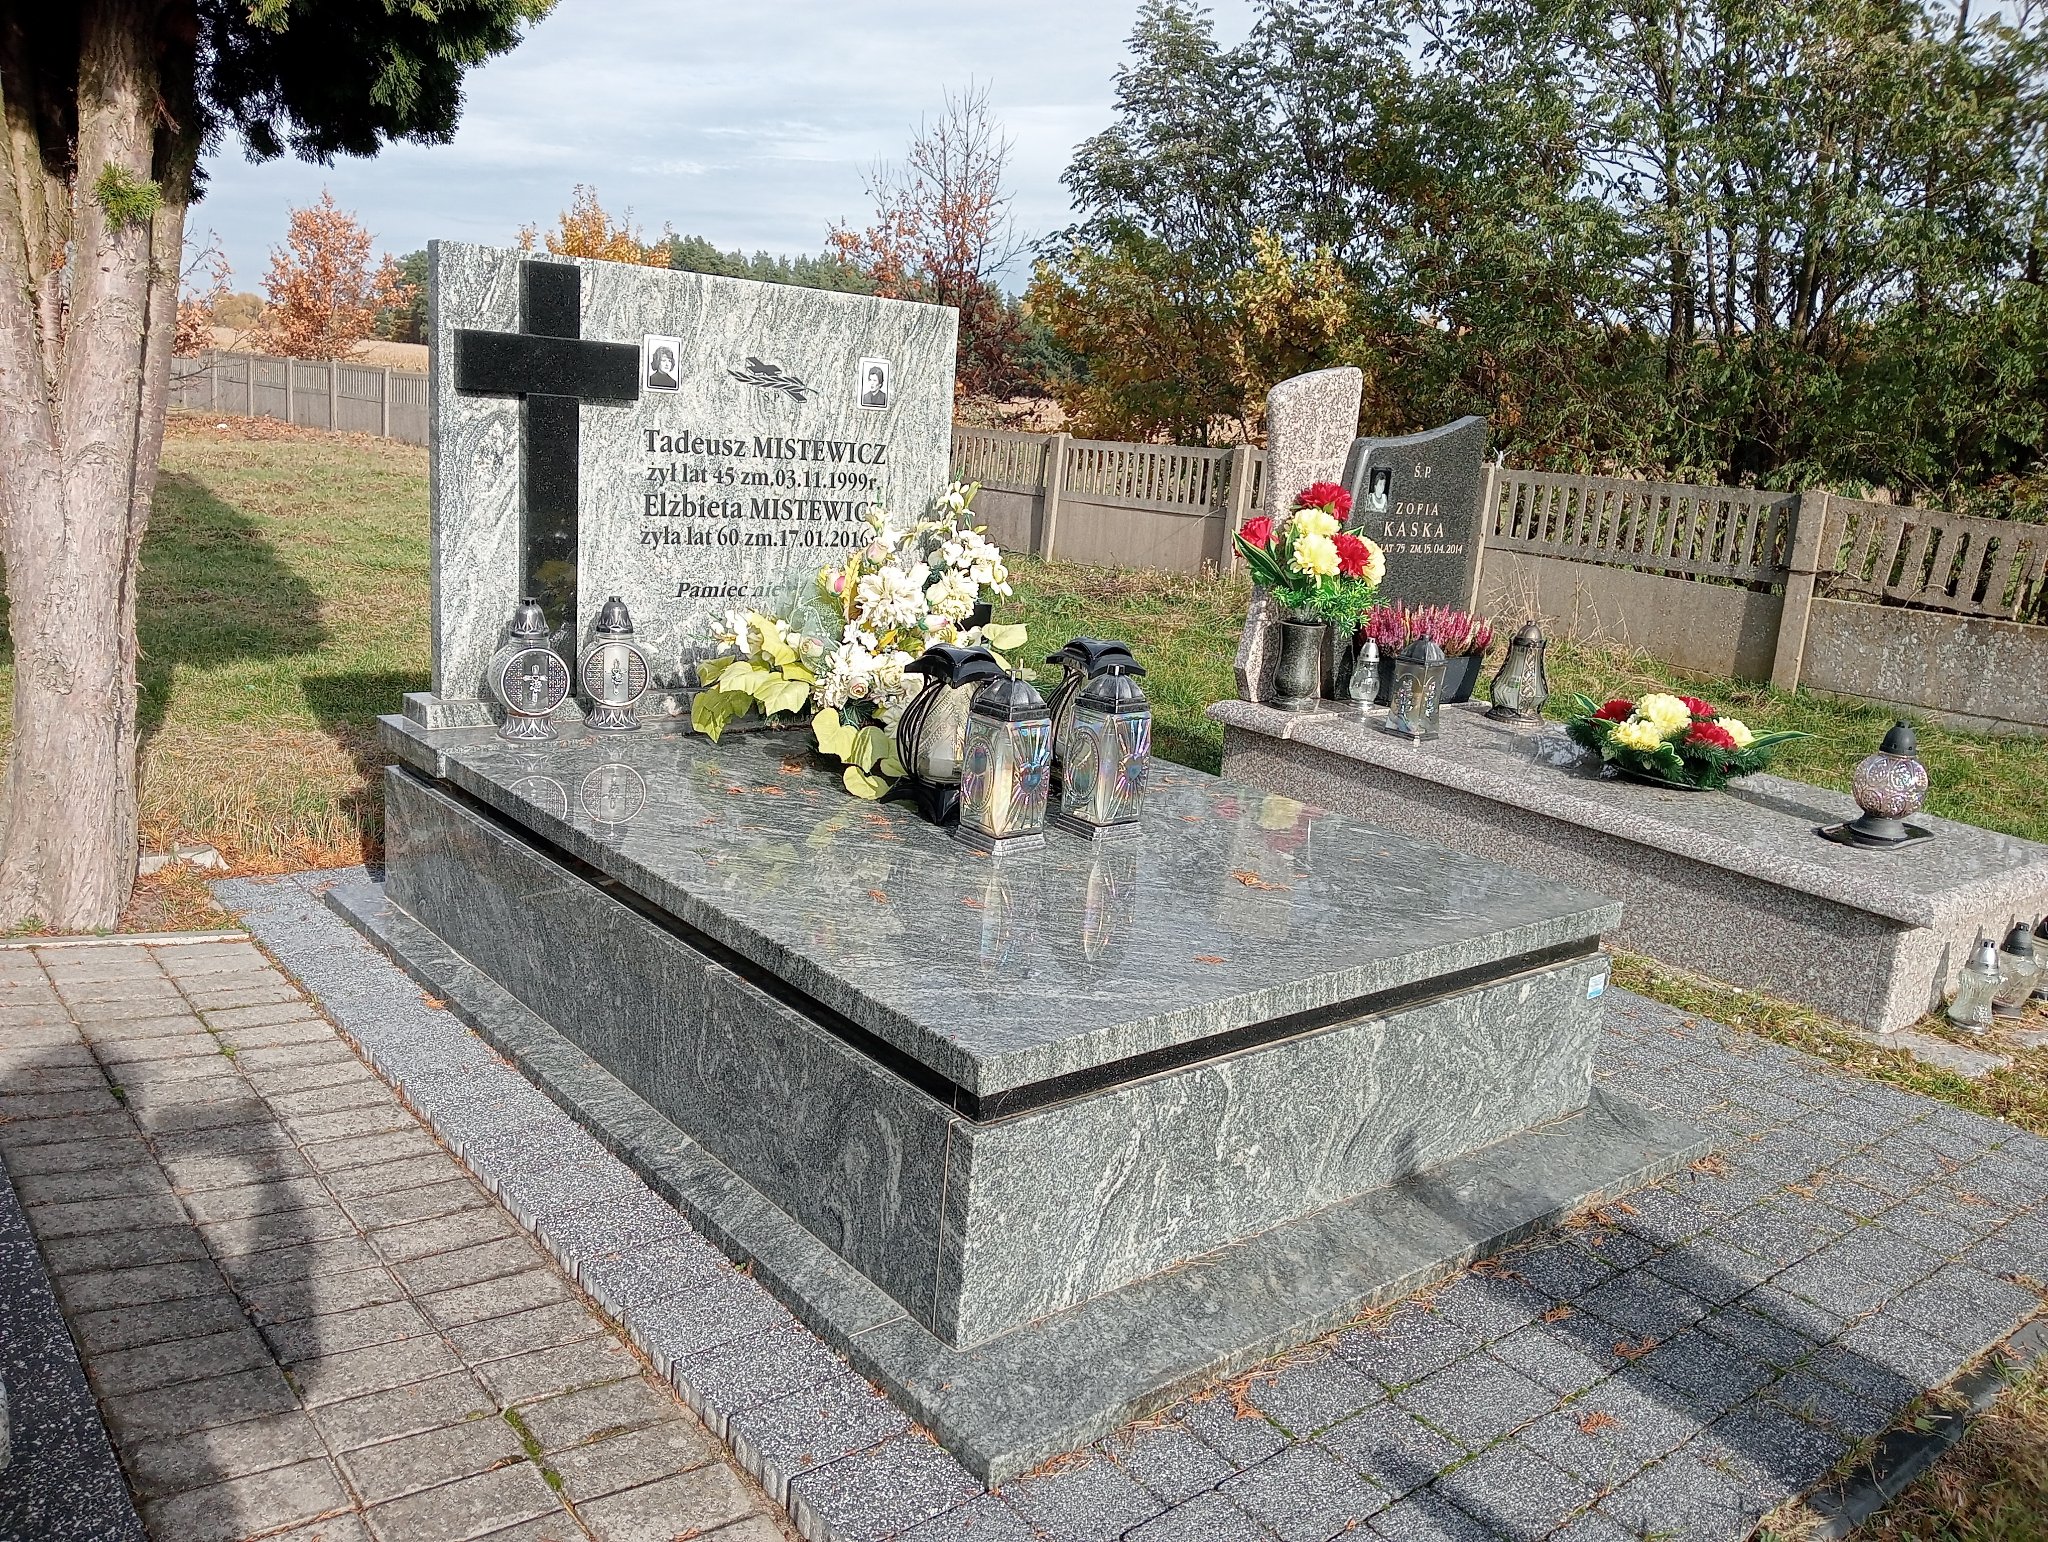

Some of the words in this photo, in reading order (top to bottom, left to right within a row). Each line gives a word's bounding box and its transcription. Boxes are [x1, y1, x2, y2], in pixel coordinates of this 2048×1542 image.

[643, 428, 747, 458] Tadeusz
[752, 435, 887, 465] MISTEWICZ
[646, 461, 677, 487] żył
[681, 462, 708, 483] lat
[712, 466, 736, 487] 45
[643, 492, 743, 519] Elżbieta
[1395, 502, 1439, 516] ZOFIA
[639, 525, 681, 550] żyła
[686, 526, 712, 546] lat
[717, 525, 739, 546] 60
[1383, 521, 1444, 538] KASKA
